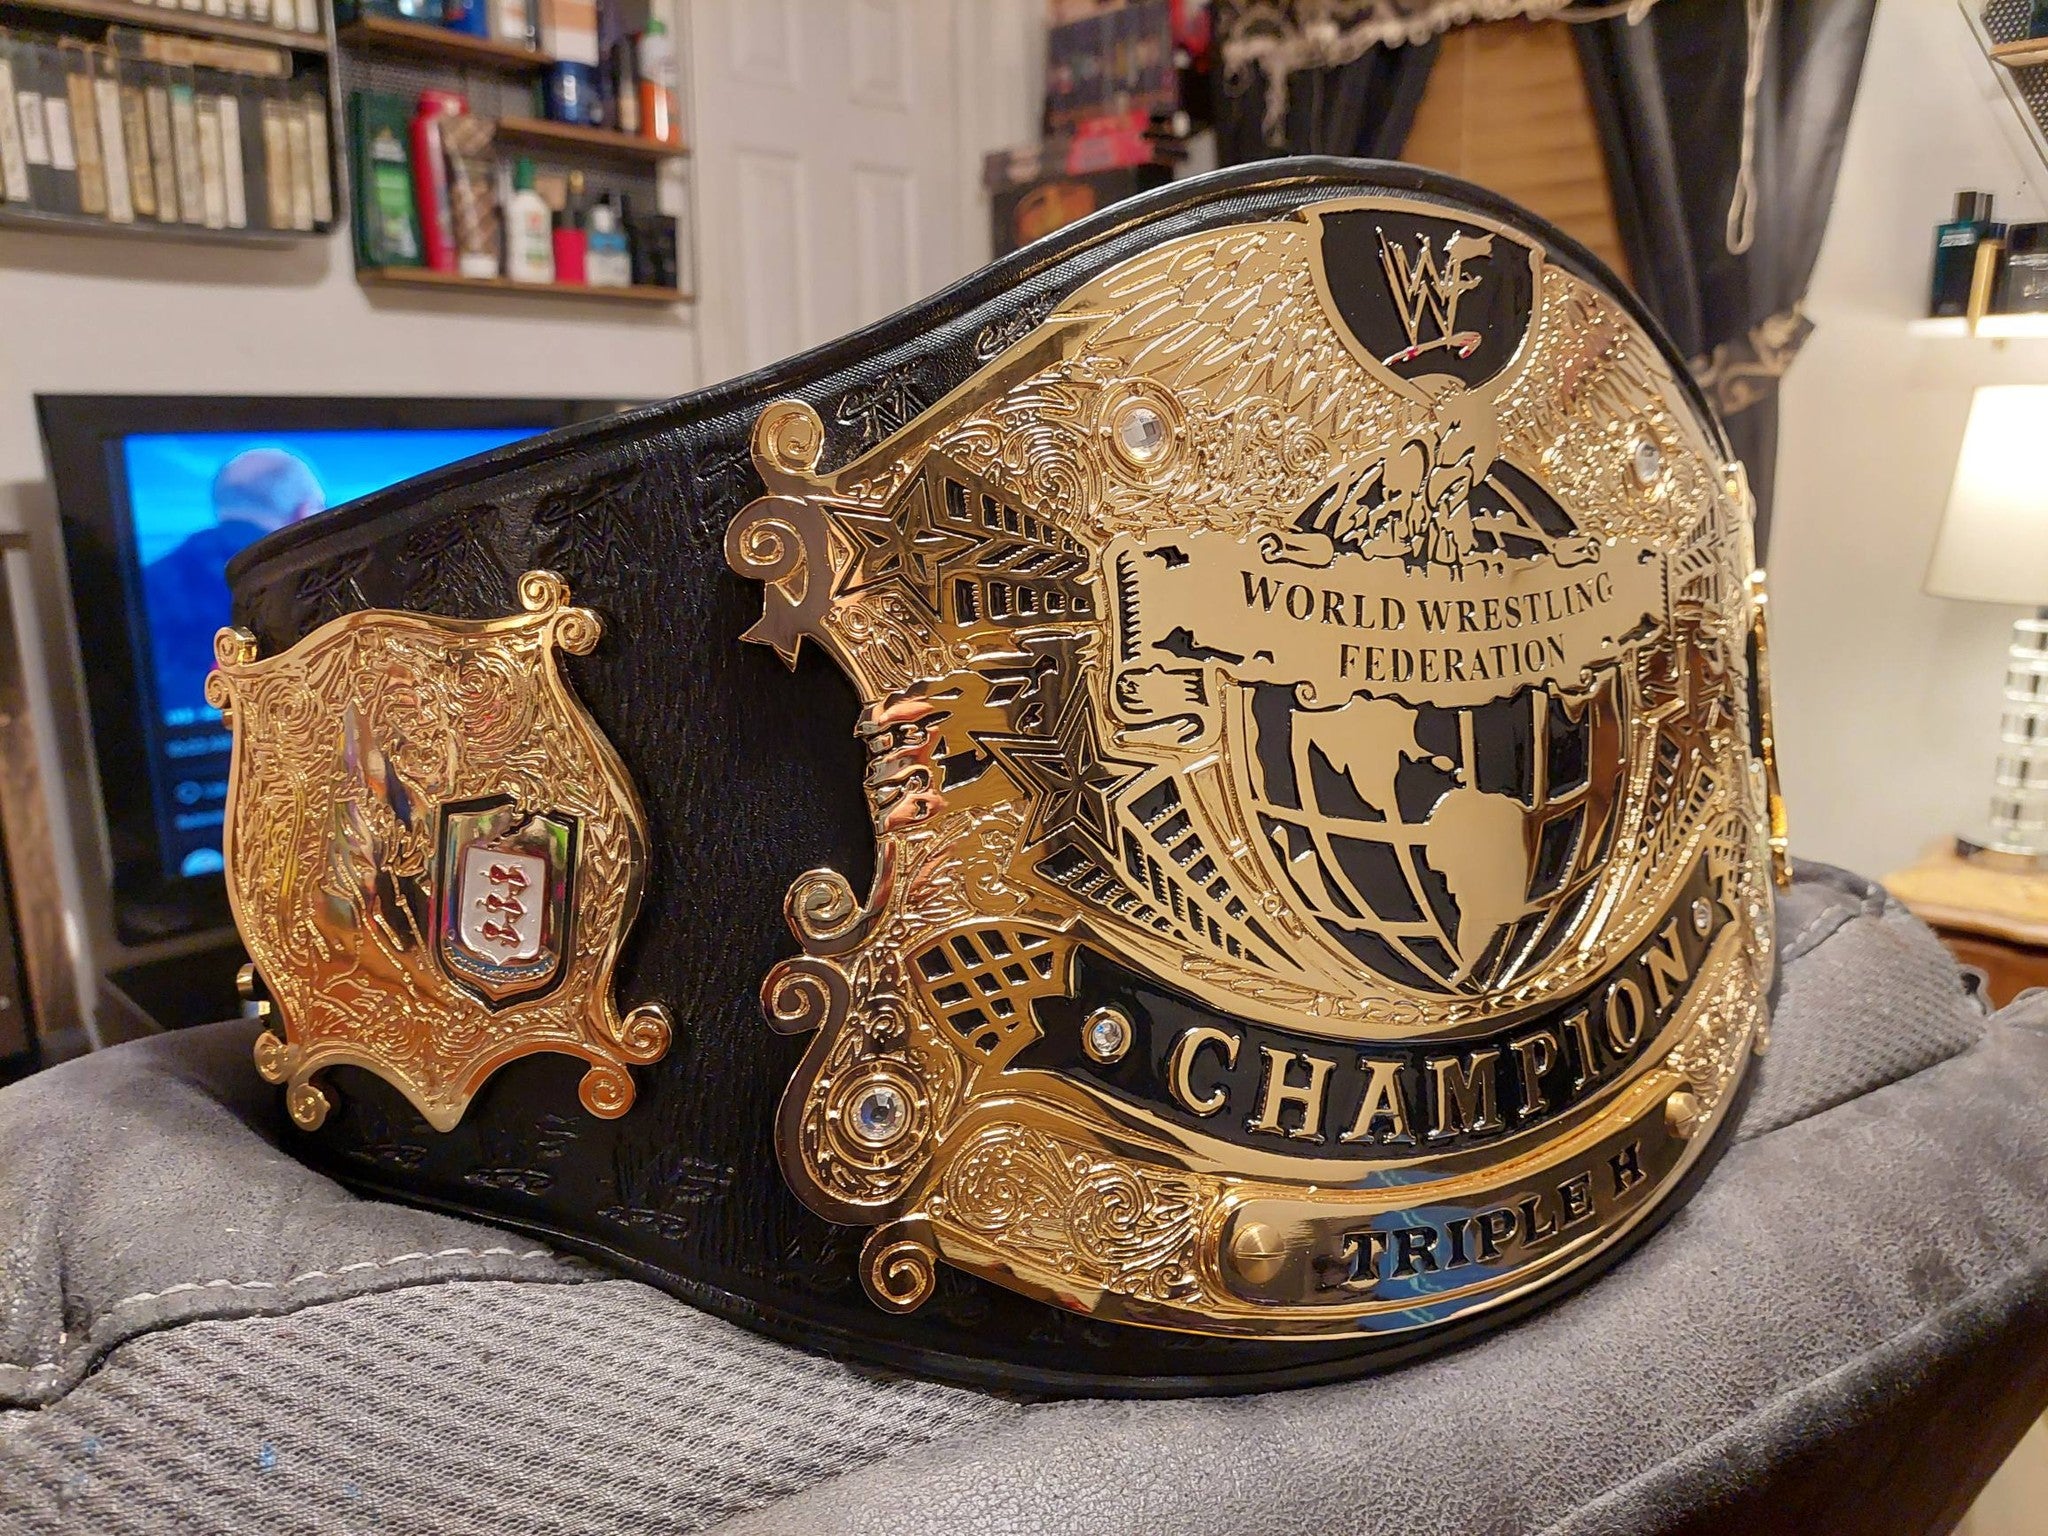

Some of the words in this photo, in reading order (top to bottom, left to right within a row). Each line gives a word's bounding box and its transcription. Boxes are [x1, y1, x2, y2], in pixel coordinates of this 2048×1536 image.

[1240, 570, 1406, 632] WORLD
[1416, 571, 1614, 634] WRESTLING
[1339, 633, 1567, 683] FEDERATION
[1167, 932, 1692, 1147] CHAMPION
[1341, 1174, 1595, 1289] TRIPLE
[1607, 1141, 1648, 1198] H
